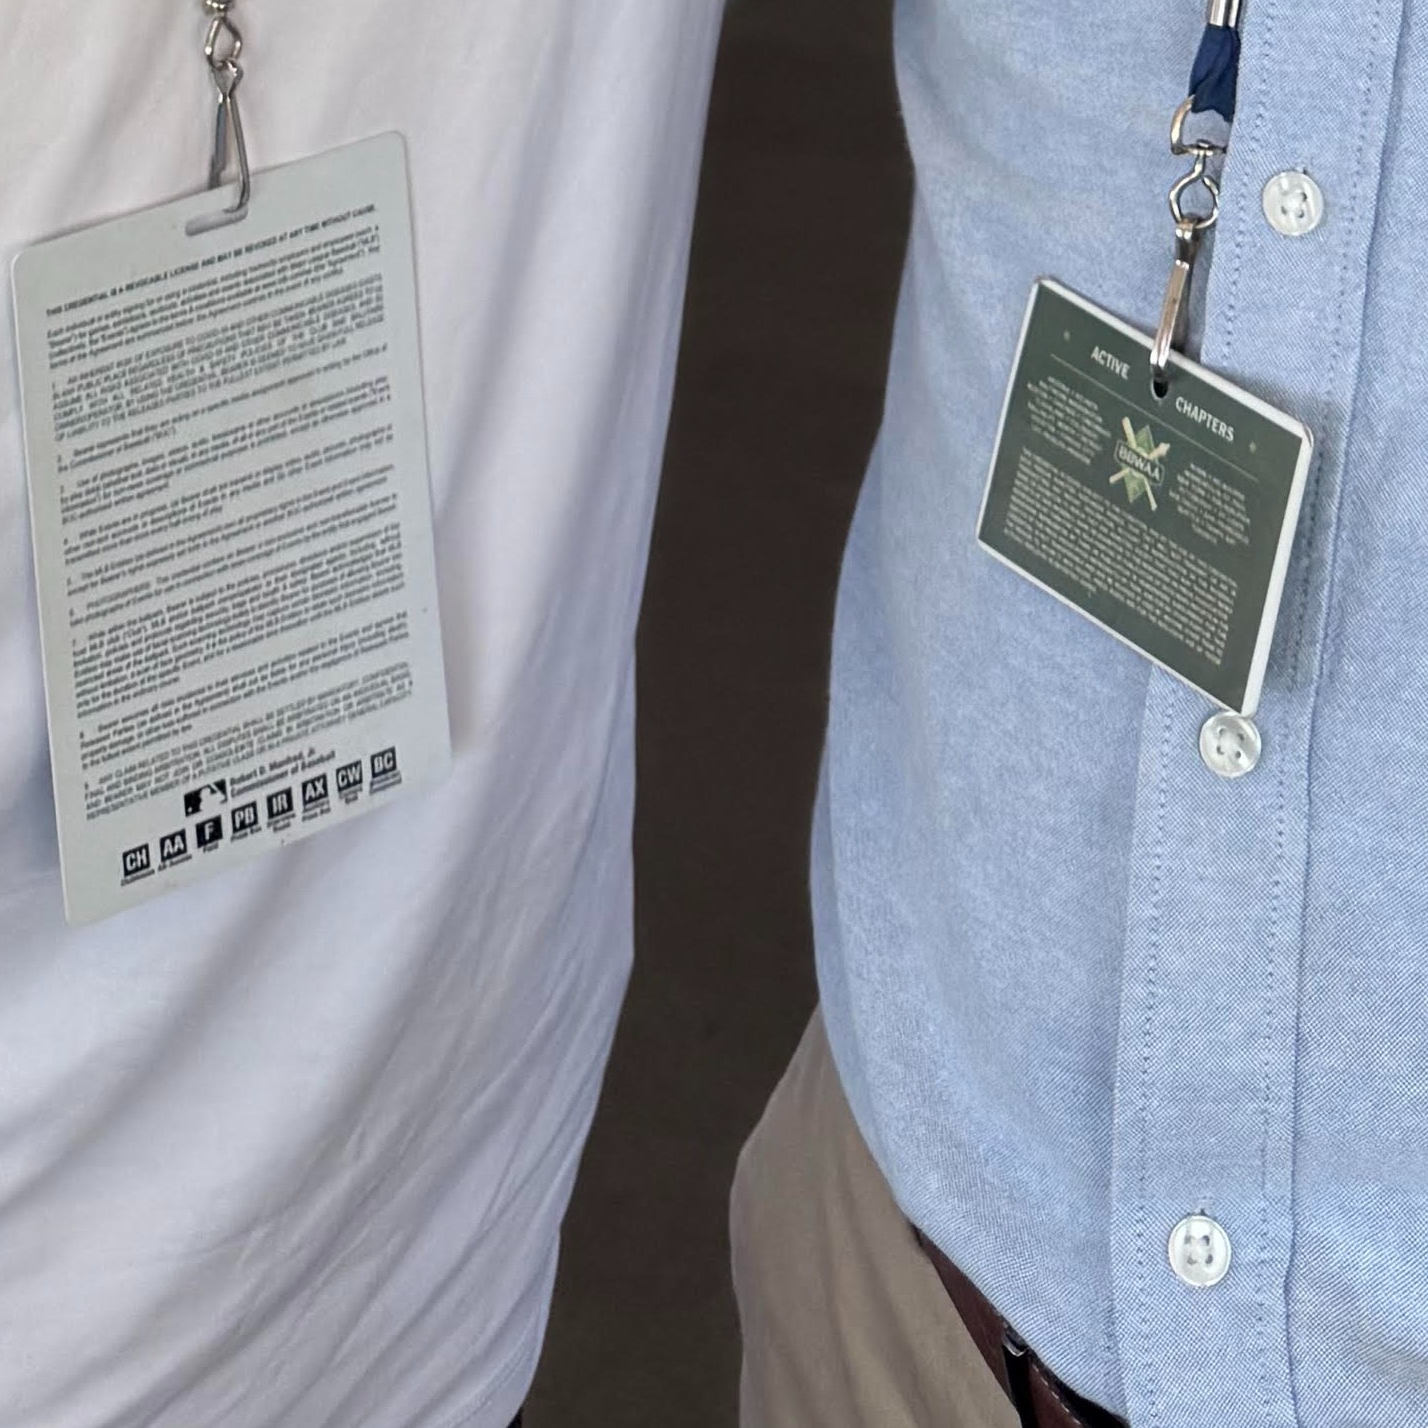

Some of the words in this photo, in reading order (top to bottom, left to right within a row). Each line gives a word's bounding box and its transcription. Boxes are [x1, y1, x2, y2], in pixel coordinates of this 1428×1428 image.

[1091, 345, 1130, 379] ACTIVE
[1175, 396, 1234, 442] CHAPTERS
[124, 846, 146, 872] CH
[162, 832, 184, 858] AA
[203, 820, 215, 841] F
[233, 804, 255, 830] PB
[271, 791, 288, 815] IR
[303, 776, 325, 802] AX
[337, 762, 361, 789] CW
[373, 749, 394, 774] BC
